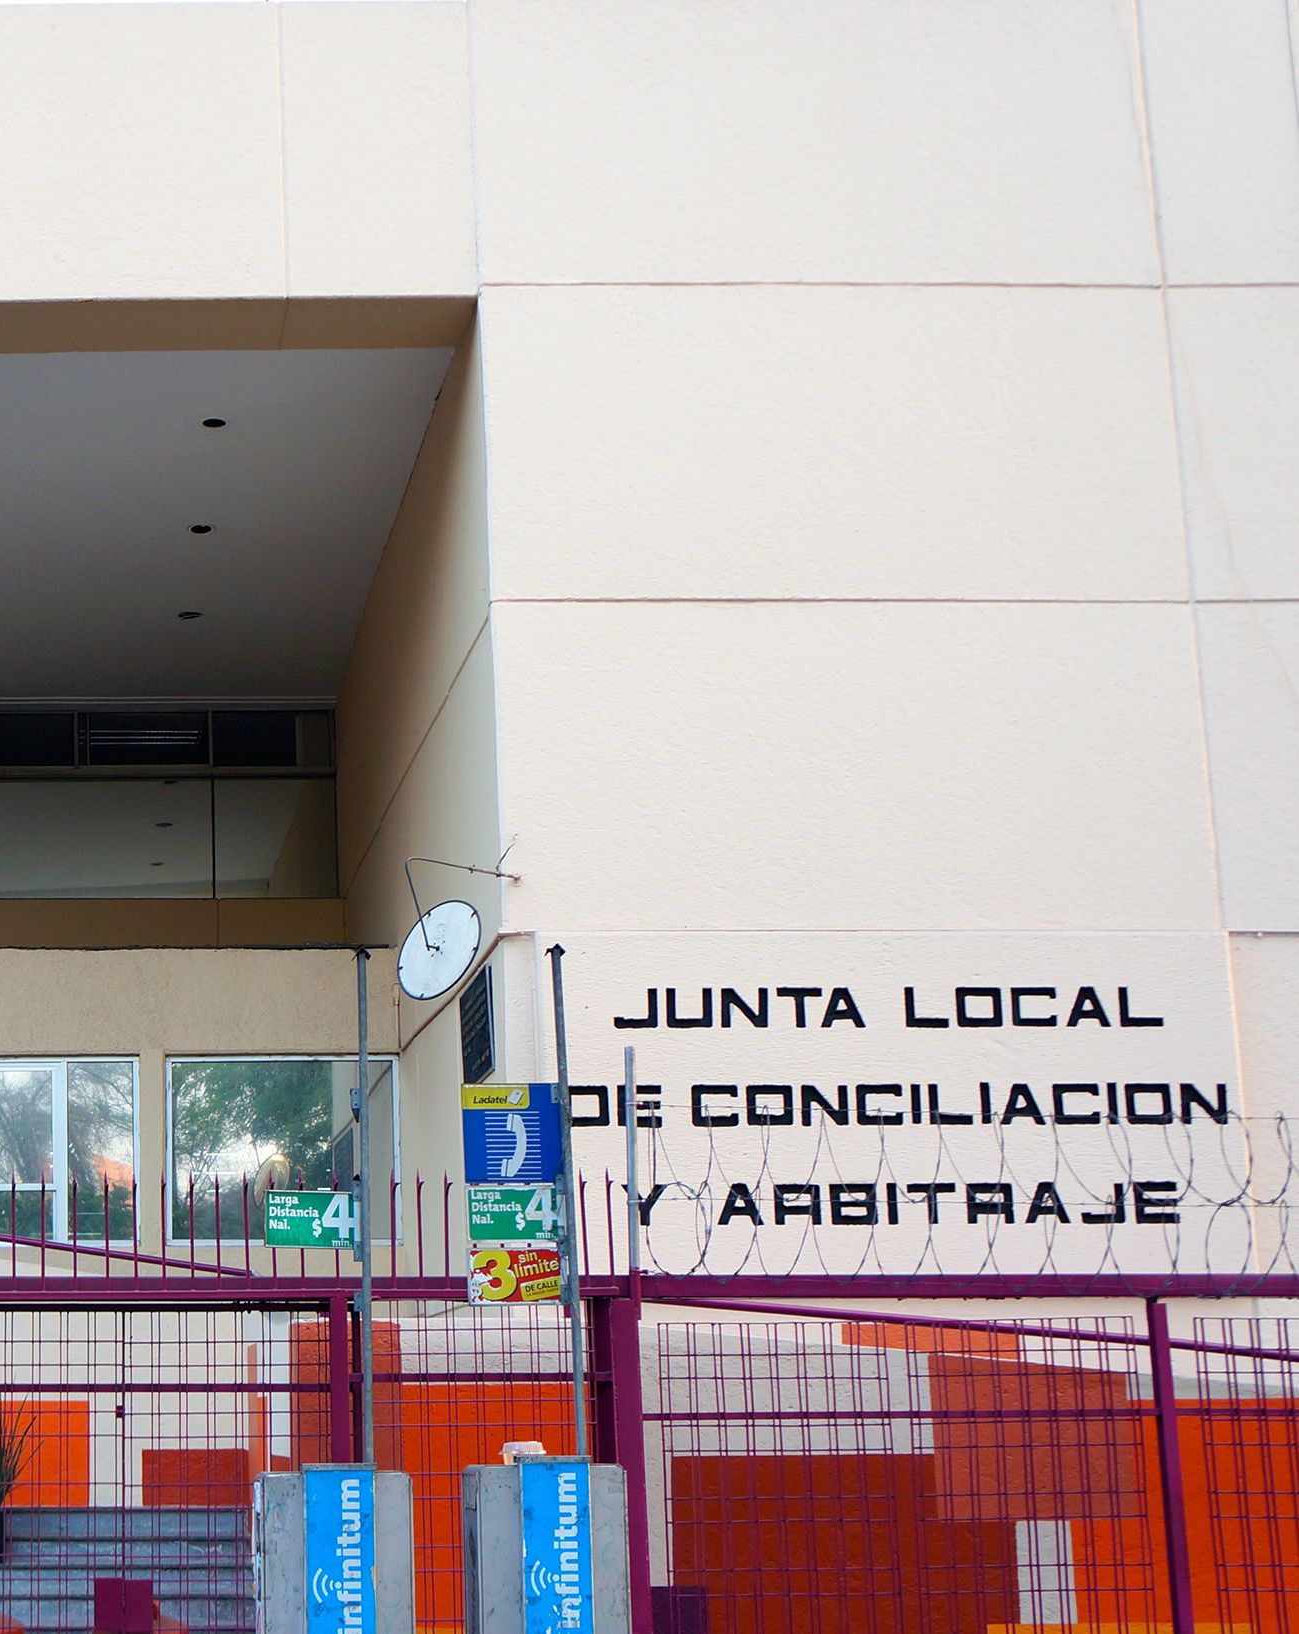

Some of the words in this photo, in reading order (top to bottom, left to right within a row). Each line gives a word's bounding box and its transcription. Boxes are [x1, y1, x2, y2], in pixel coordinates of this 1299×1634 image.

[614, 987, 866, 1029] JUNTA
[905, 986, 1164, 1029] LOCAL
[473, 1095, 508, 1104] Ladatel
[568, 1084, 663, 1129] DE
[691, 1082, 1230, 1128] CONCILIACION
[269, 1194, 299, 1207] Larga
[470, 1190, 501, 1202] Larga
[472, 1201, 522, 1212] Distancia
[621, 1184, 667, 1226] Y
[717, 1181, 1180, 1226] ARBITRAJE
[269, 1206, 319, 1217] Distancia
[269, 1219, 291, 1230] Nal.
[472, 1214, 494, 1225] Nal.
[518, 1251, 538, 1263] sin
[525, 1285, 535, 1293] DE
[536, 1280, 559, 1290] CALLE
[336, 1478, 363, 1634] infinitum
[553, 1472, 582, 1629] infinitum
